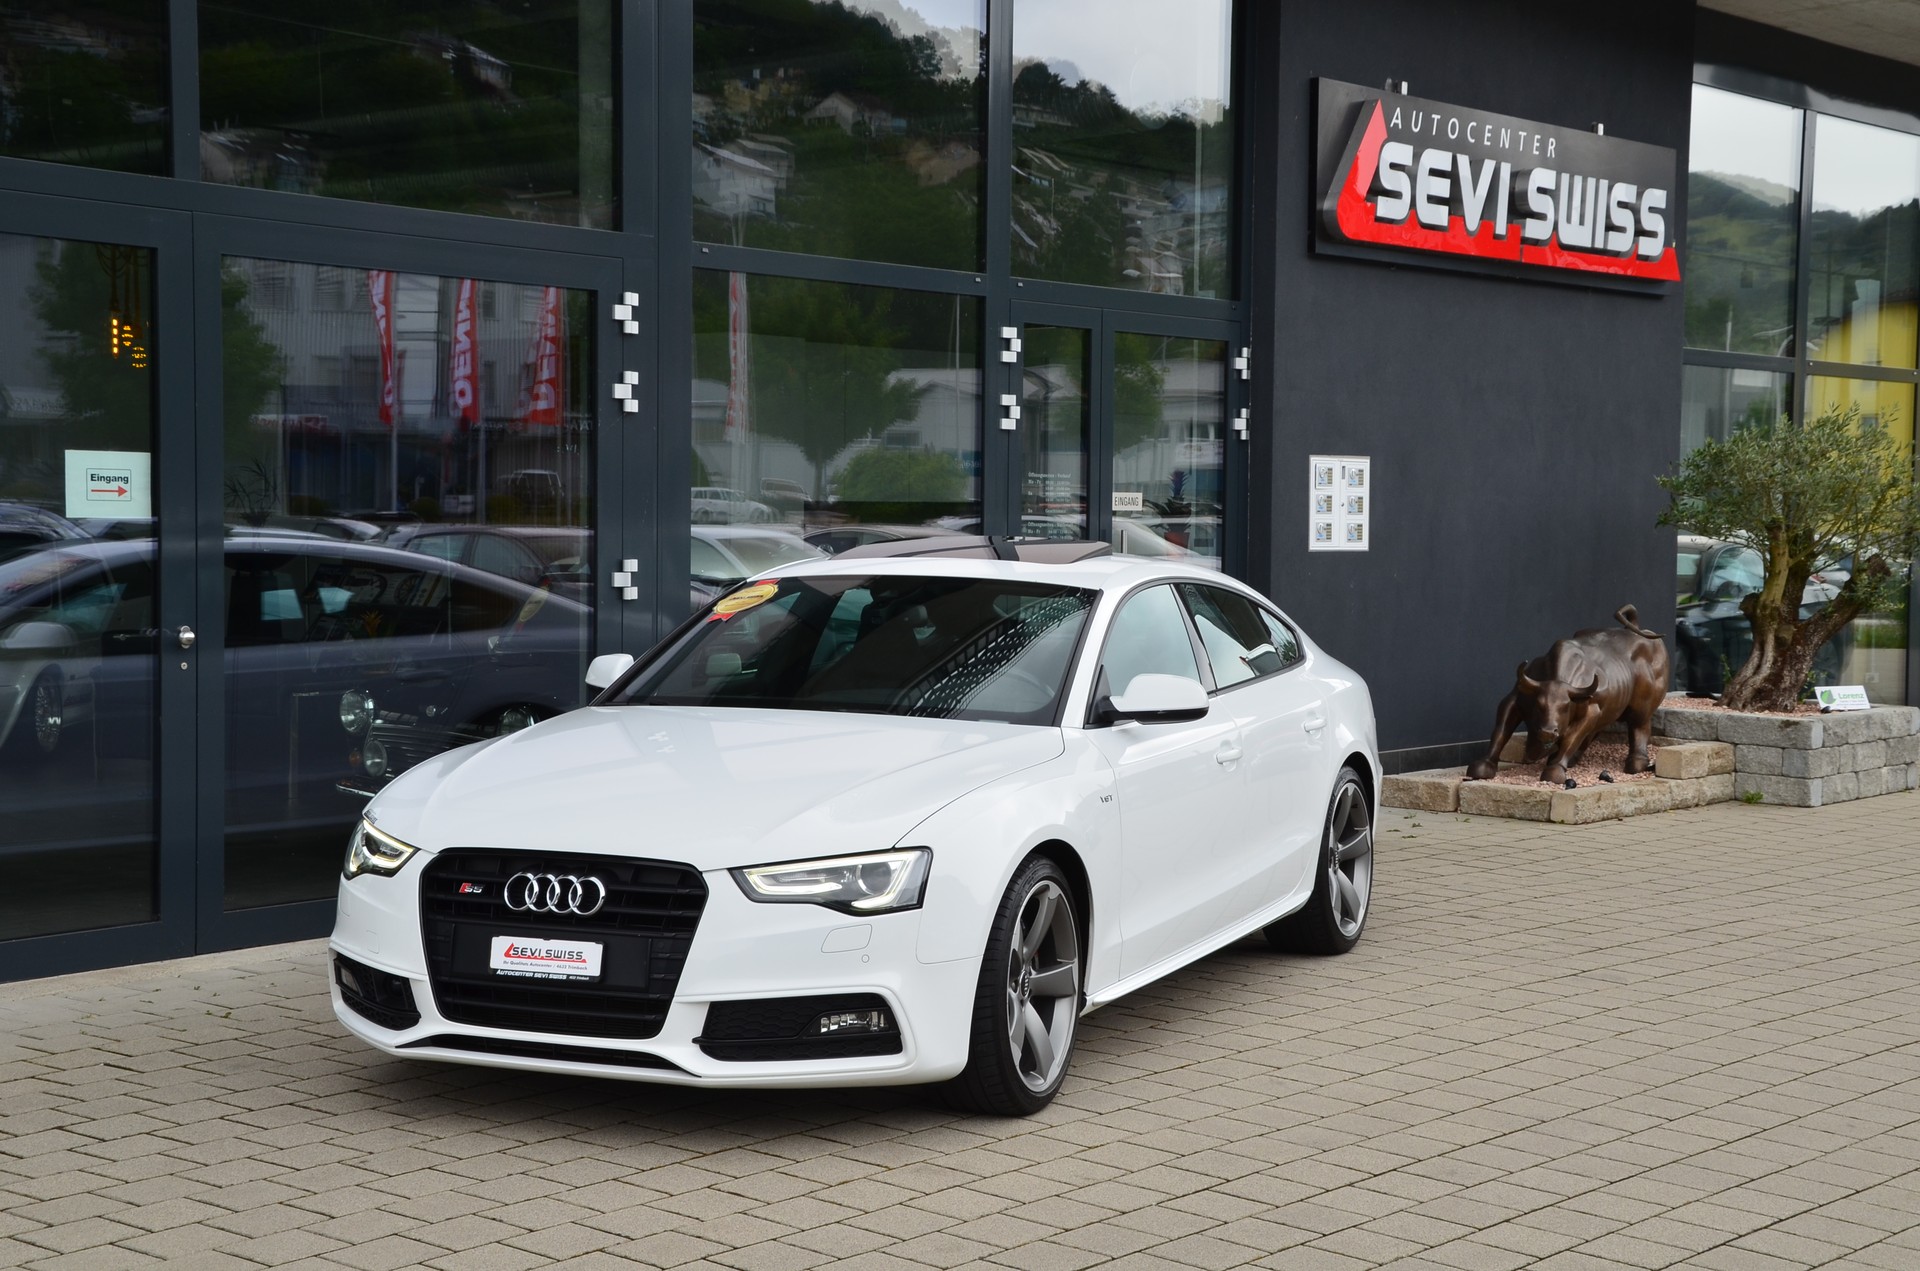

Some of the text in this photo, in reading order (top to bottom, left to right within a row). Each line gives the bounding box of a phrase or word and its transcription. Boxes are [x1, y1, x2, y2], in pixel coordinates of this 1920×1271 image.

[1390, 107, 1557, 158] AUTOCENTER
[1375, 141, 1667, 256] SEVI SWISS
[90, 473, 129, 484] Eingang
[1114, 496, 1139, 506] EINGANG
[511, 946, 584, 960] SEVI SWISS
